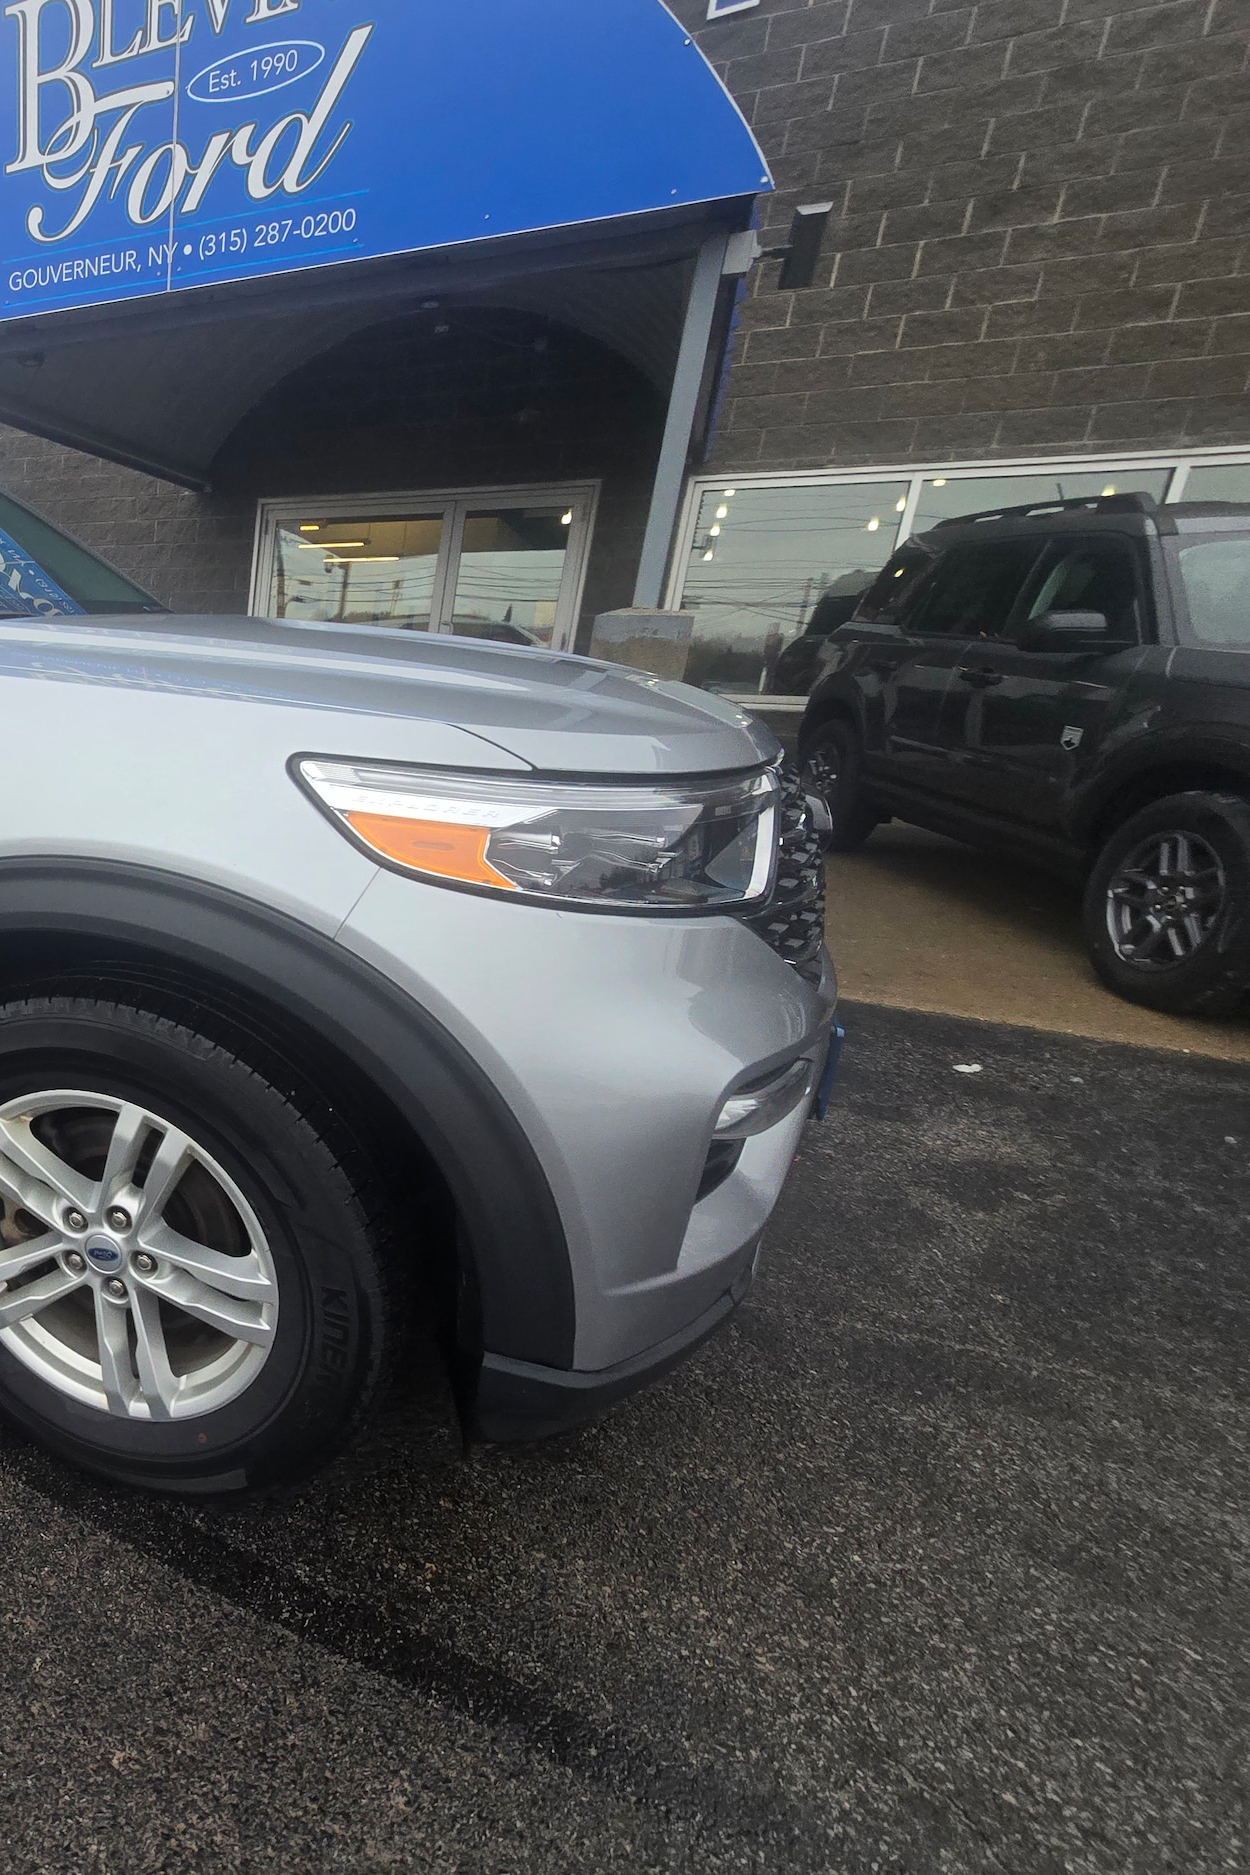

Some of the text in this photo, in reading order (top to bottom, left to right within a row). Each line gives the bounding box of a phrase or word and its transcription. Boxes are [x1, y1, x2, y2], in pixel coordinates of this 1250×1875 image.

[208, 49, 299, 93] Est. 1990
[26, 25, 374, 243] Ford
[8, 208, 357, 291] GOUVERNEUR, NY (315) 287-0200
[352, 795, 501, 819] EXPLORER
